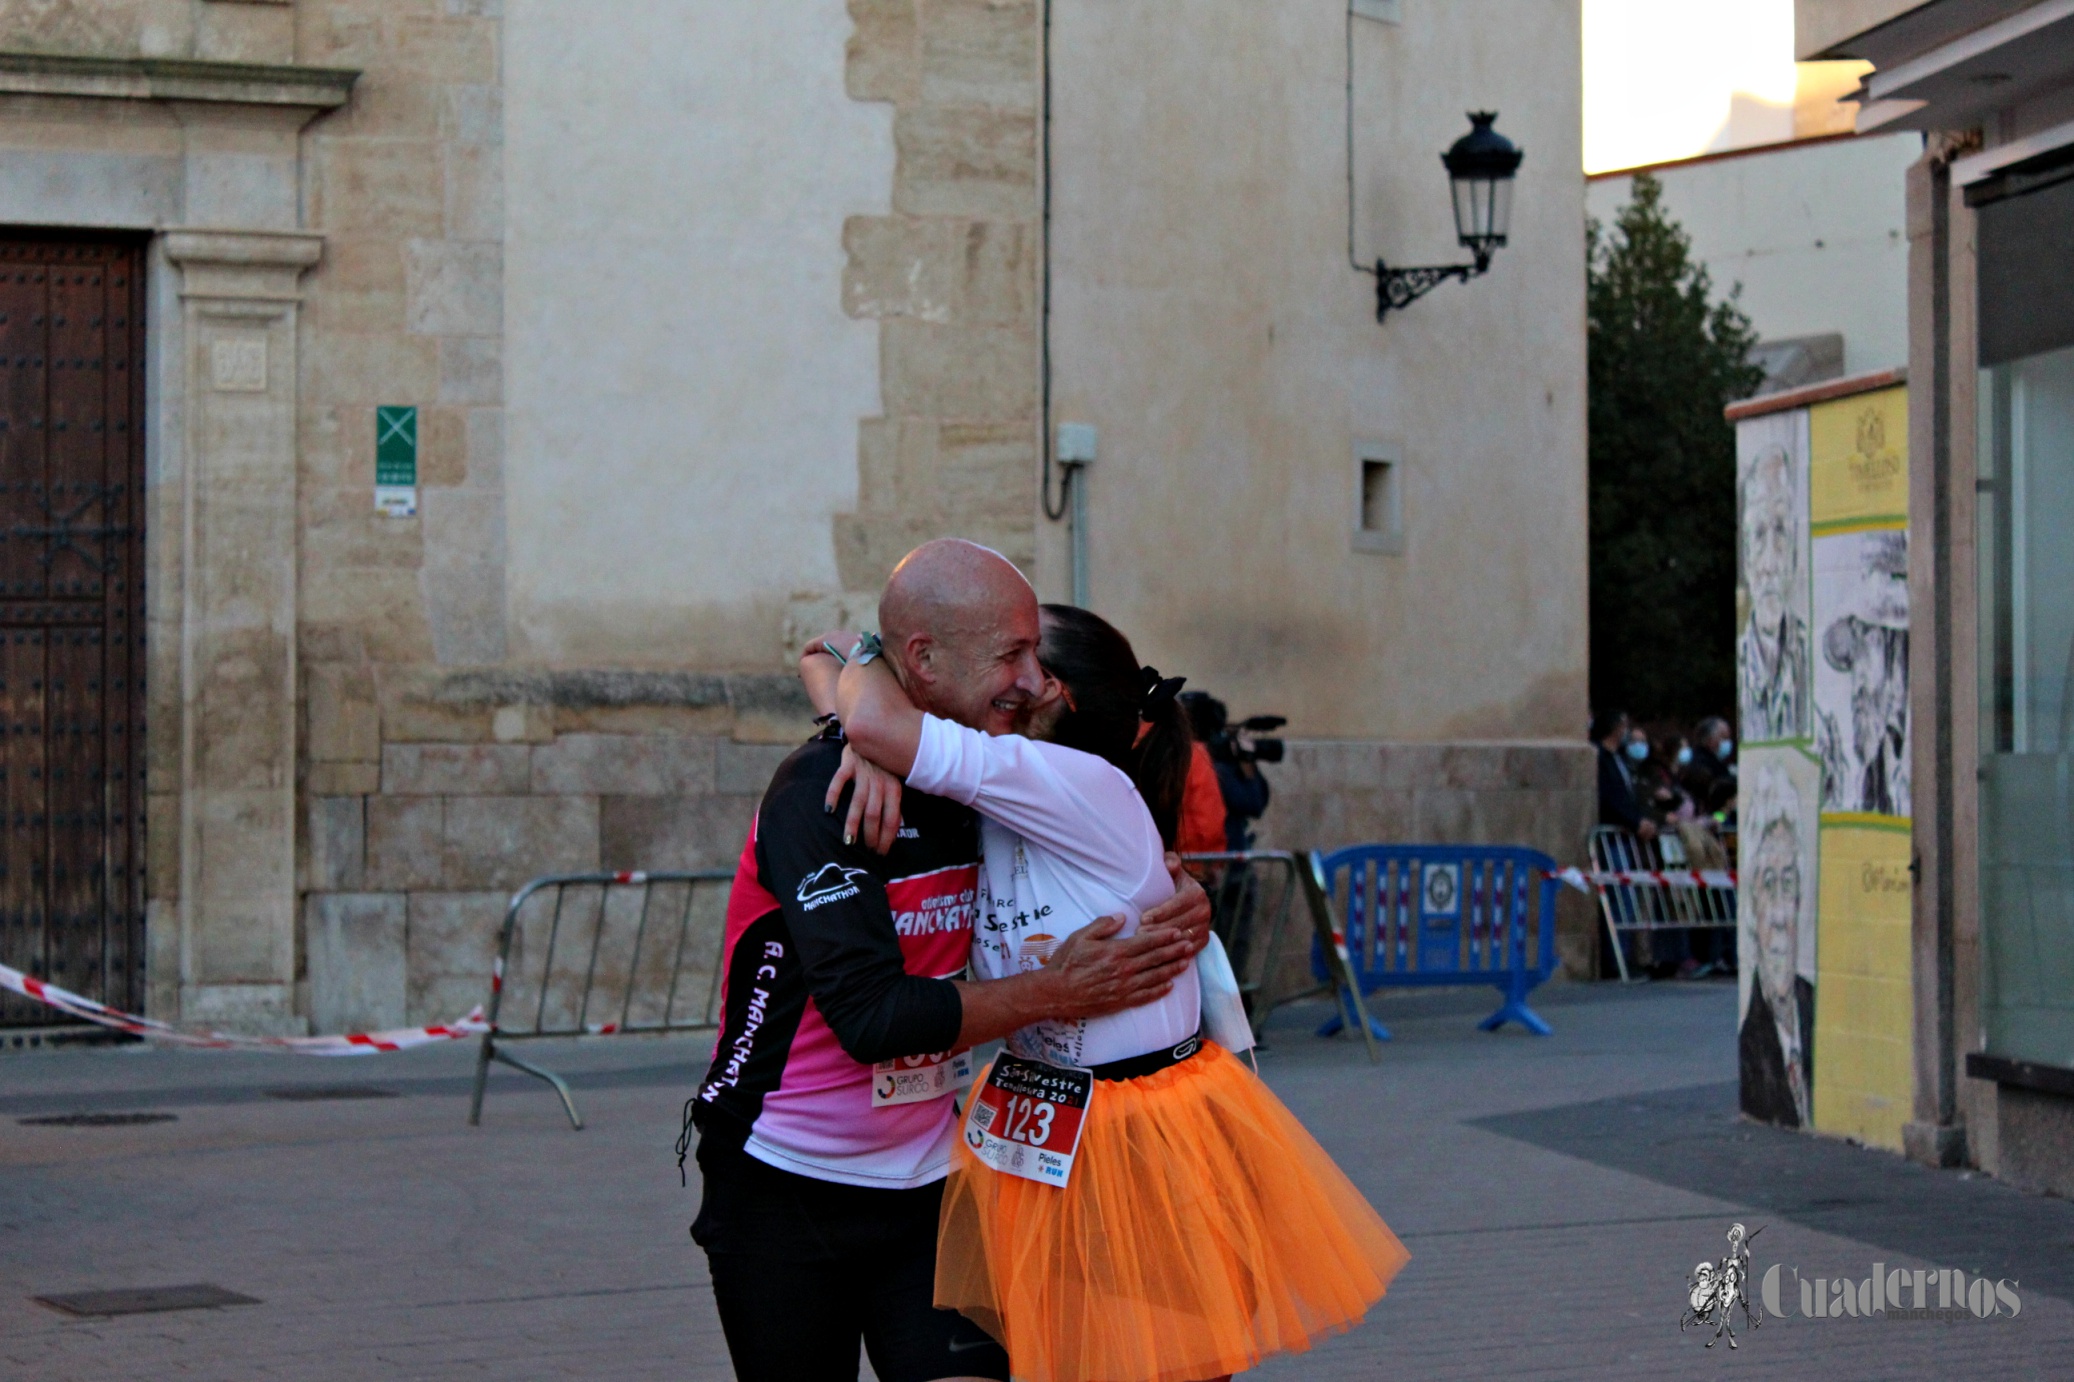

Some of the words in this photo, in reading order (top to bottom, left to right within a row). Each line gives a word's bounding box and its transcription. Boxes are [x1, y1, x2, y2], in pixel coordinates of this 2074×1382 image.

[804, 886, 860, 912] MANCHATHON
[896, 1082, 930, 1096] SURCO
[1048, 1090, 1080, 1107] 2021
[1003, 1095, 1055, 1147] 123
[1038, 1152, 1062, 1167] Pieles
[1045, 1166, 1064, 1178] RUN
